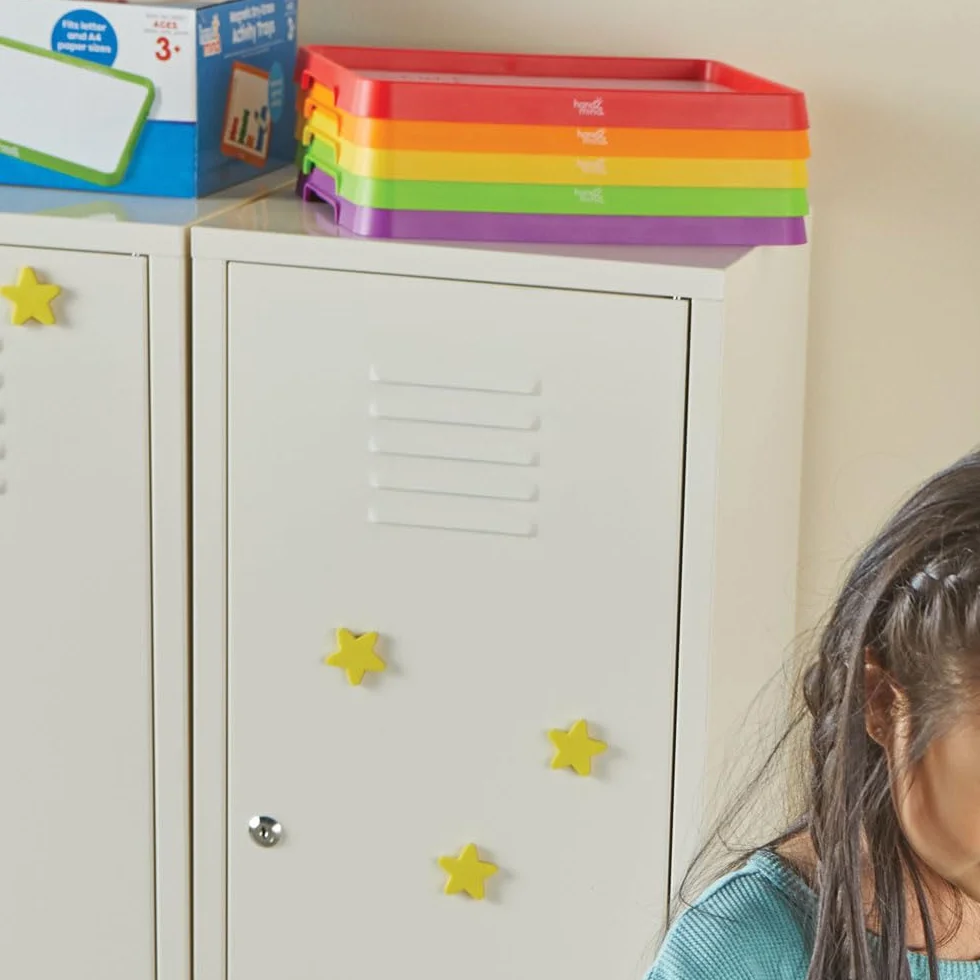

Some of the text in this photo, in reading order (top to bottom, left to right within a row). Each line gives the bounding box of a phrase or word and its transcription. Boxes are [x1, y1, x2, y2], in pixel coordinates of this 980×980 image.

[62, 20, 107, 31] Fits letter
[66, 32, 102, 41] and A4
[57, 42, 112, 53] paper sizes
[155, 36, 181, 61] 3+
